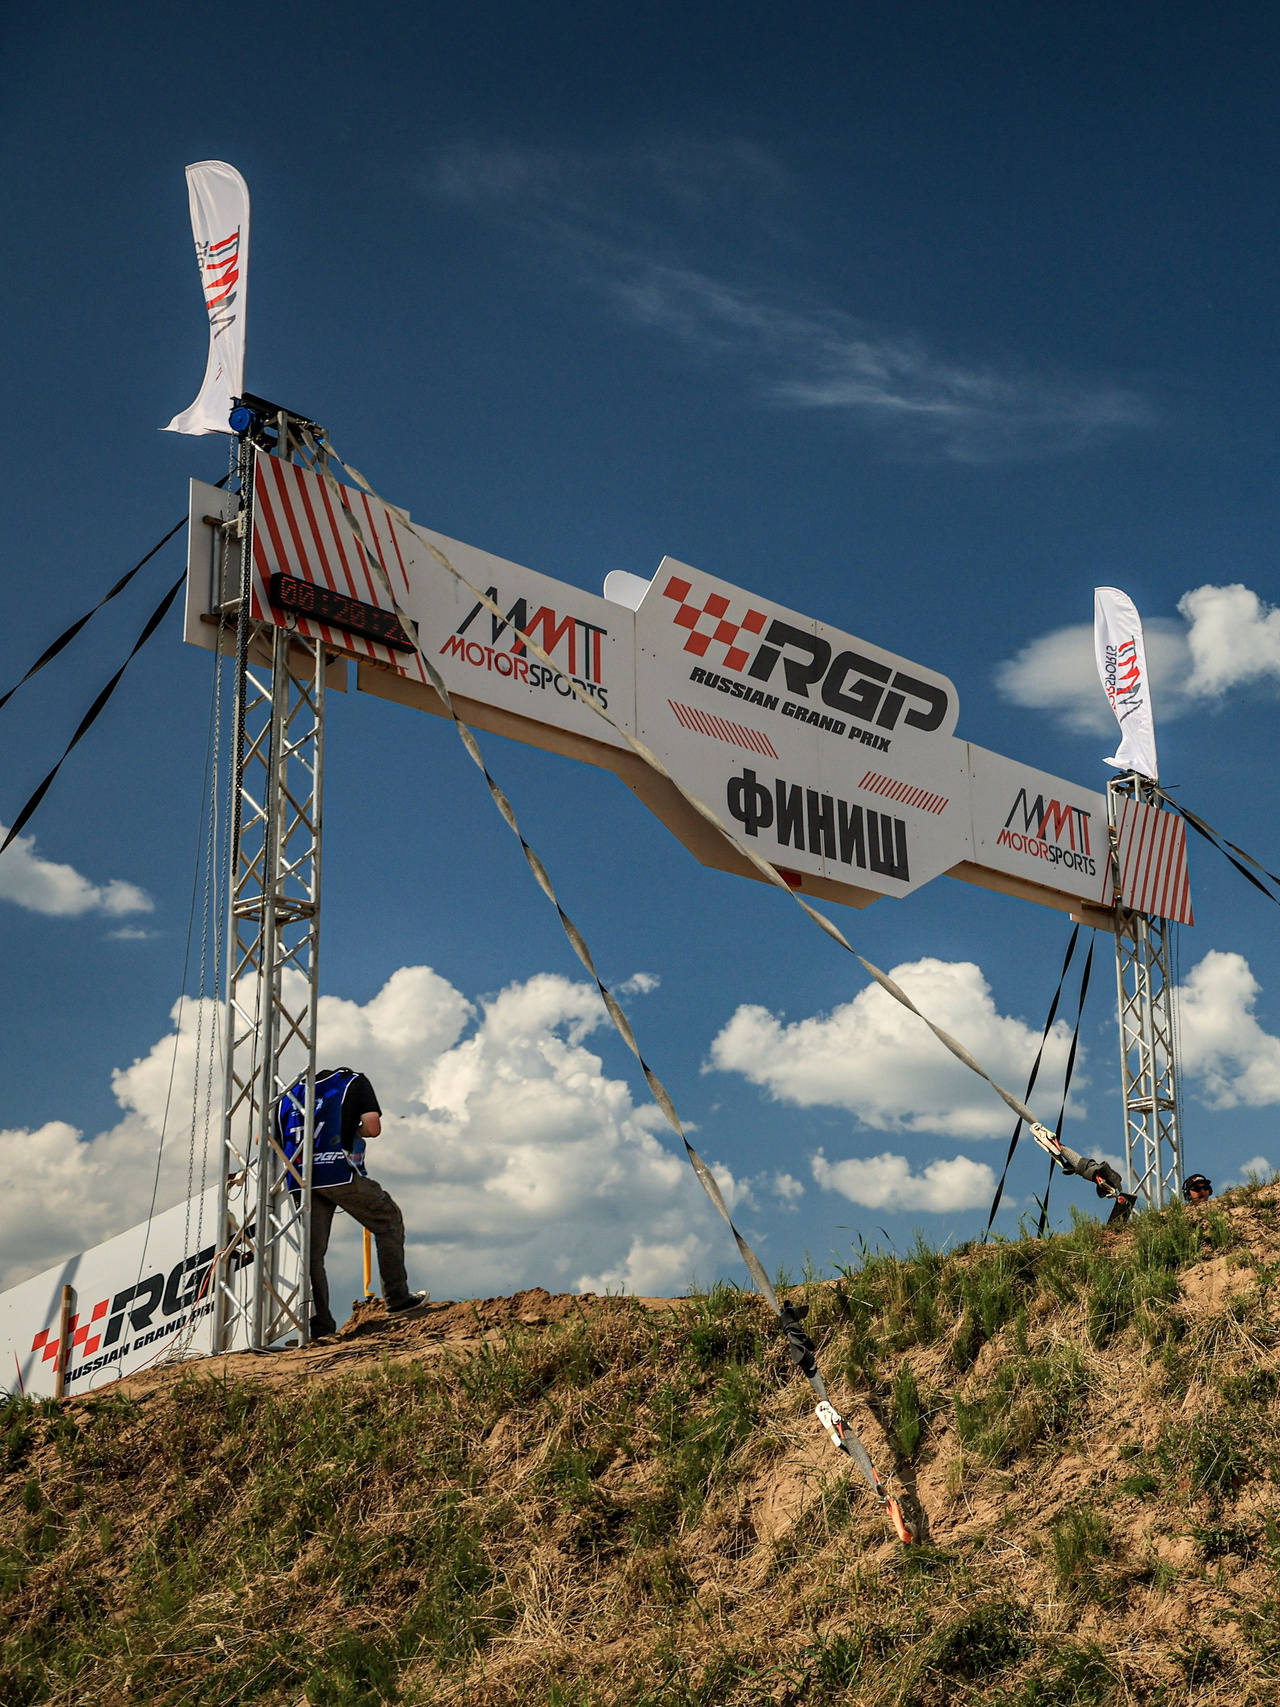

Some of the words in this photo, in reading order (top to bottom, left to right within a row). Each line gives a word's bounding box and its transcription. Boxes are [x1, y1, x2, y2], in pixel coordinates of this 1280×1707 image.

[456, 586, 608, 685] MMT
[747, 619, 949, 732] RGP
[689, 666, 780, 712] RUSSIAN
[781, 701, 847, 736] GRAND
[848, 725, 893, 753] PRIX
[726, 767, 910, 882] ФИНИШ
[996, 827, 1096, 877] MOTORSPORTS
[1004, 787, 1092, 857] MMT
[63, 1342, 131, 1385] RUSSIAN
[133, 1314, 188, 1351] GRAND
[189, 1301, 215, 1323] PRI
